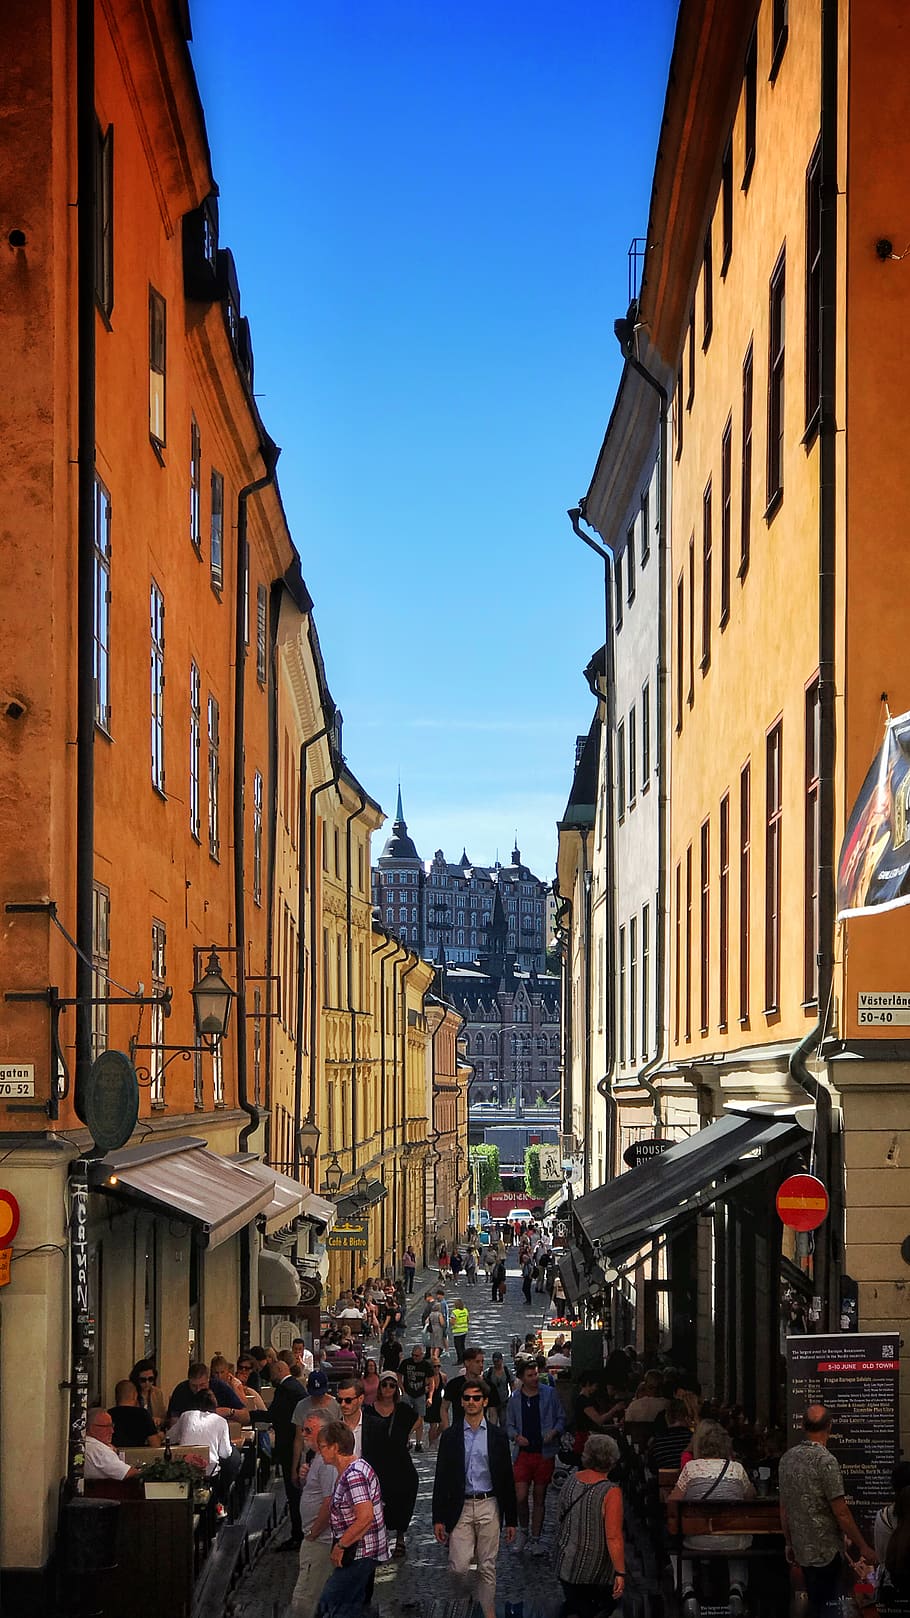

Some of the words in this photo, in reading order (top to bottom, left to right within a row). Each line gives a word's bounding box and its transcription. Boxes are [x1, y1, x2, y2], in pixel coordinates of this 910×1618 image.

[860, 1012, 893, 1022] 50-40
[0, 1084, 29, 1095] 70-52
[636, 1145, 665, 1155] HOUSE
[342, 1237, 348, 1247] &
[350, 1237, 367, 1247] Bistro
